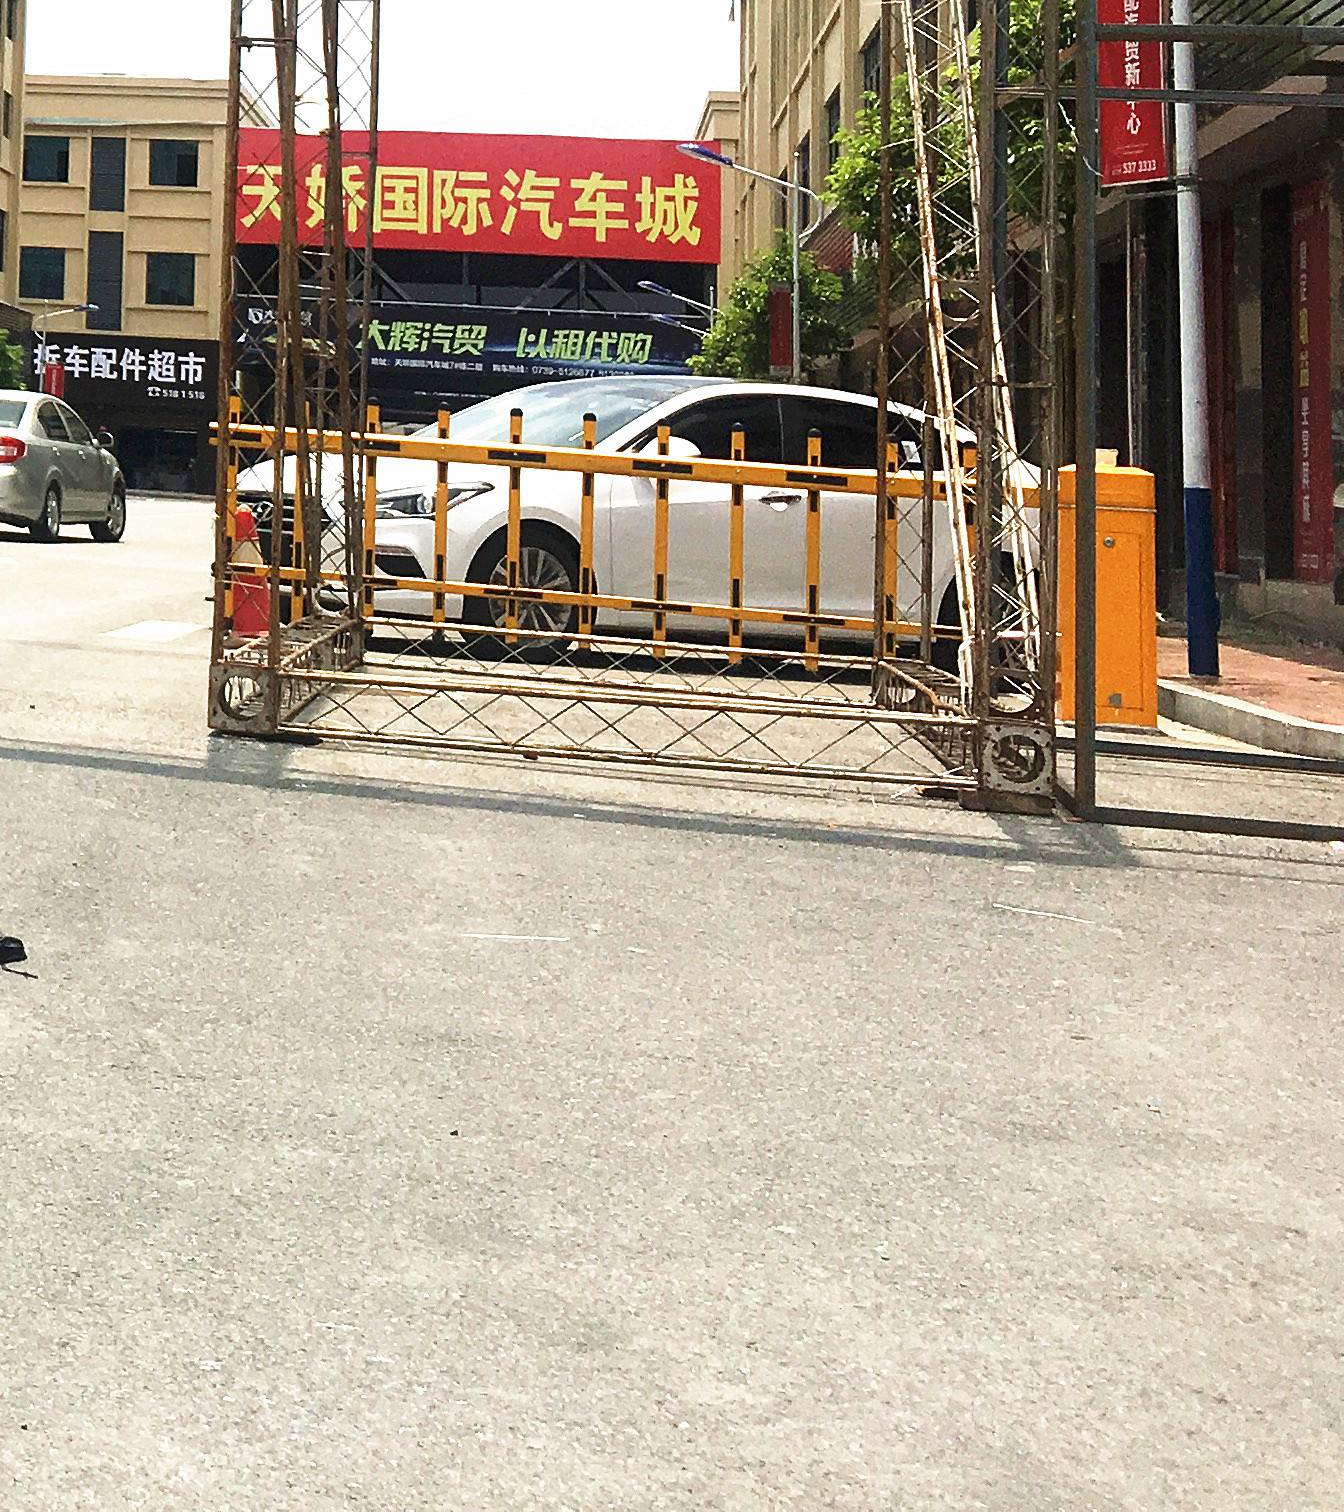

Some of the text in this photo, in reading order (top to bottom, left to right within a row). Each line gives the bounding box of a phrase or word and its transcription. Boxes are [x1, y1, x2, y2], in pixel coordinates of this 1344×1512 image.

[241, 164, 703, 246] 天娇国际汽车城
[515, 327, 653, 364] 以租代购
